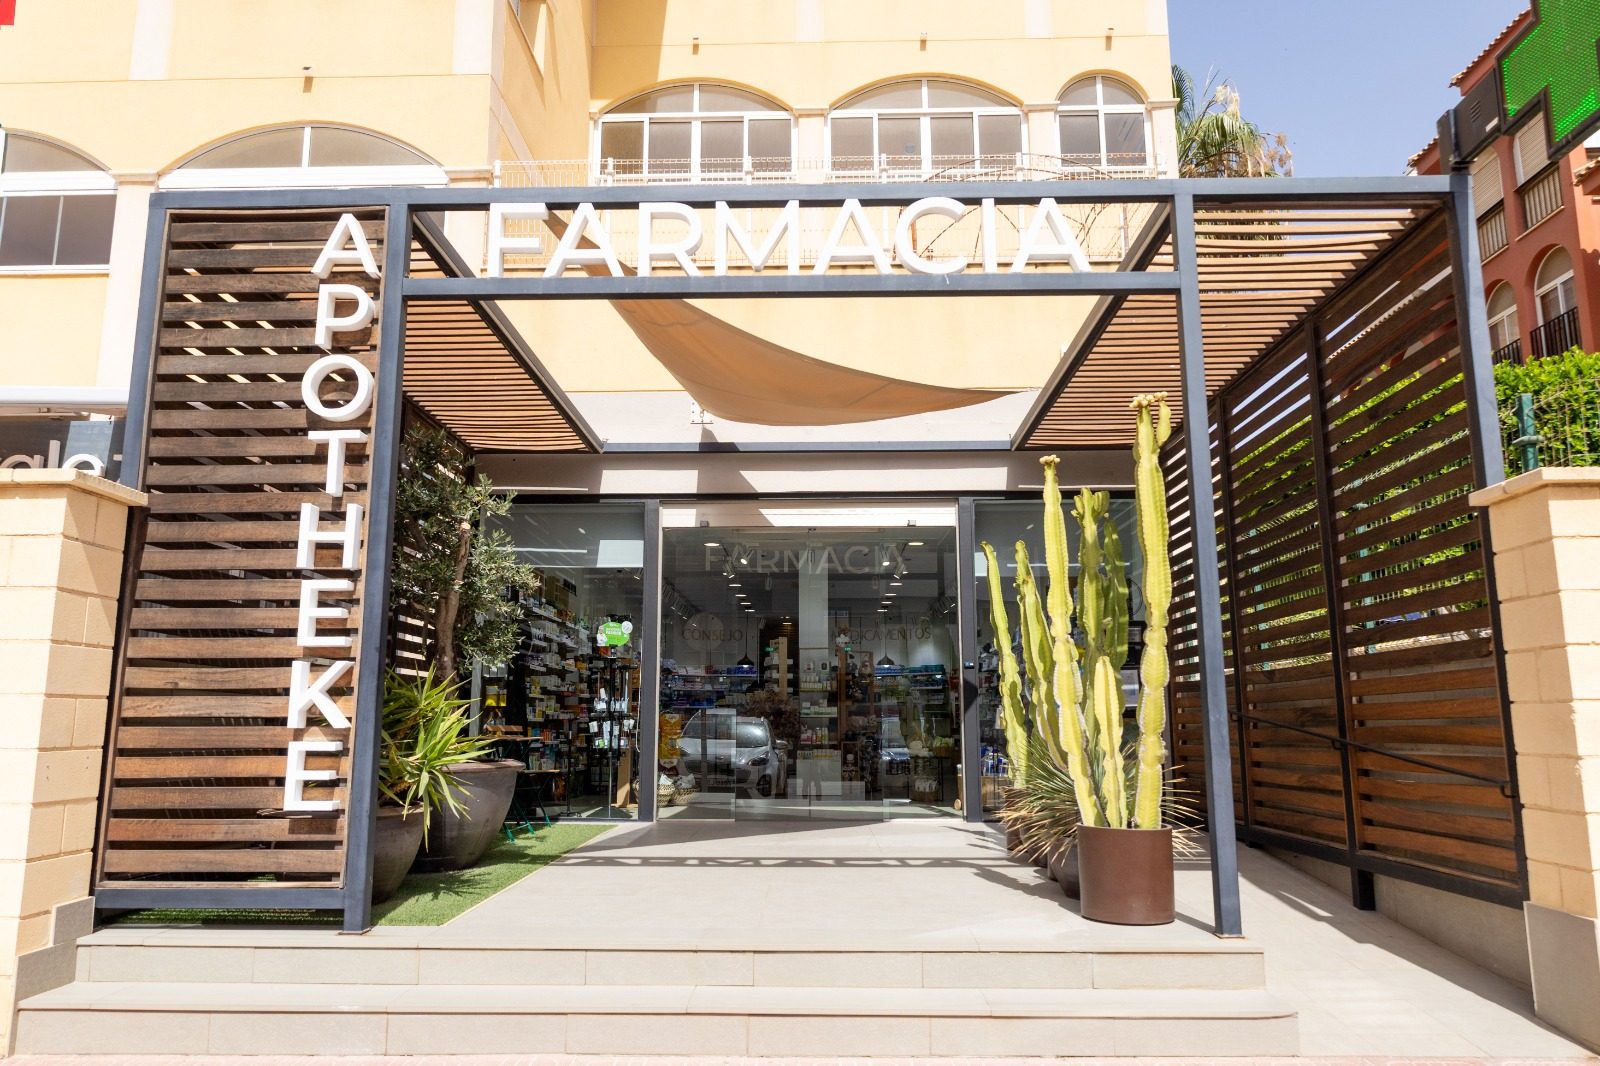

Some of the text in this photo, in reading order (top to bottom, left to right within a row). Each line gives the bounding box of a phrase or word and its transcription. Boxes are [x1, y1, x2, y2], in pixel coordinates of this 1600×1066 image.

[487, 196, 1092, 278] FARMACIA
[283, 212, 382, 812] APOTHEKE
[681, 628, 743, 641] CONSEJO
[831, 626, 931, 641] MDICAMENTOS
